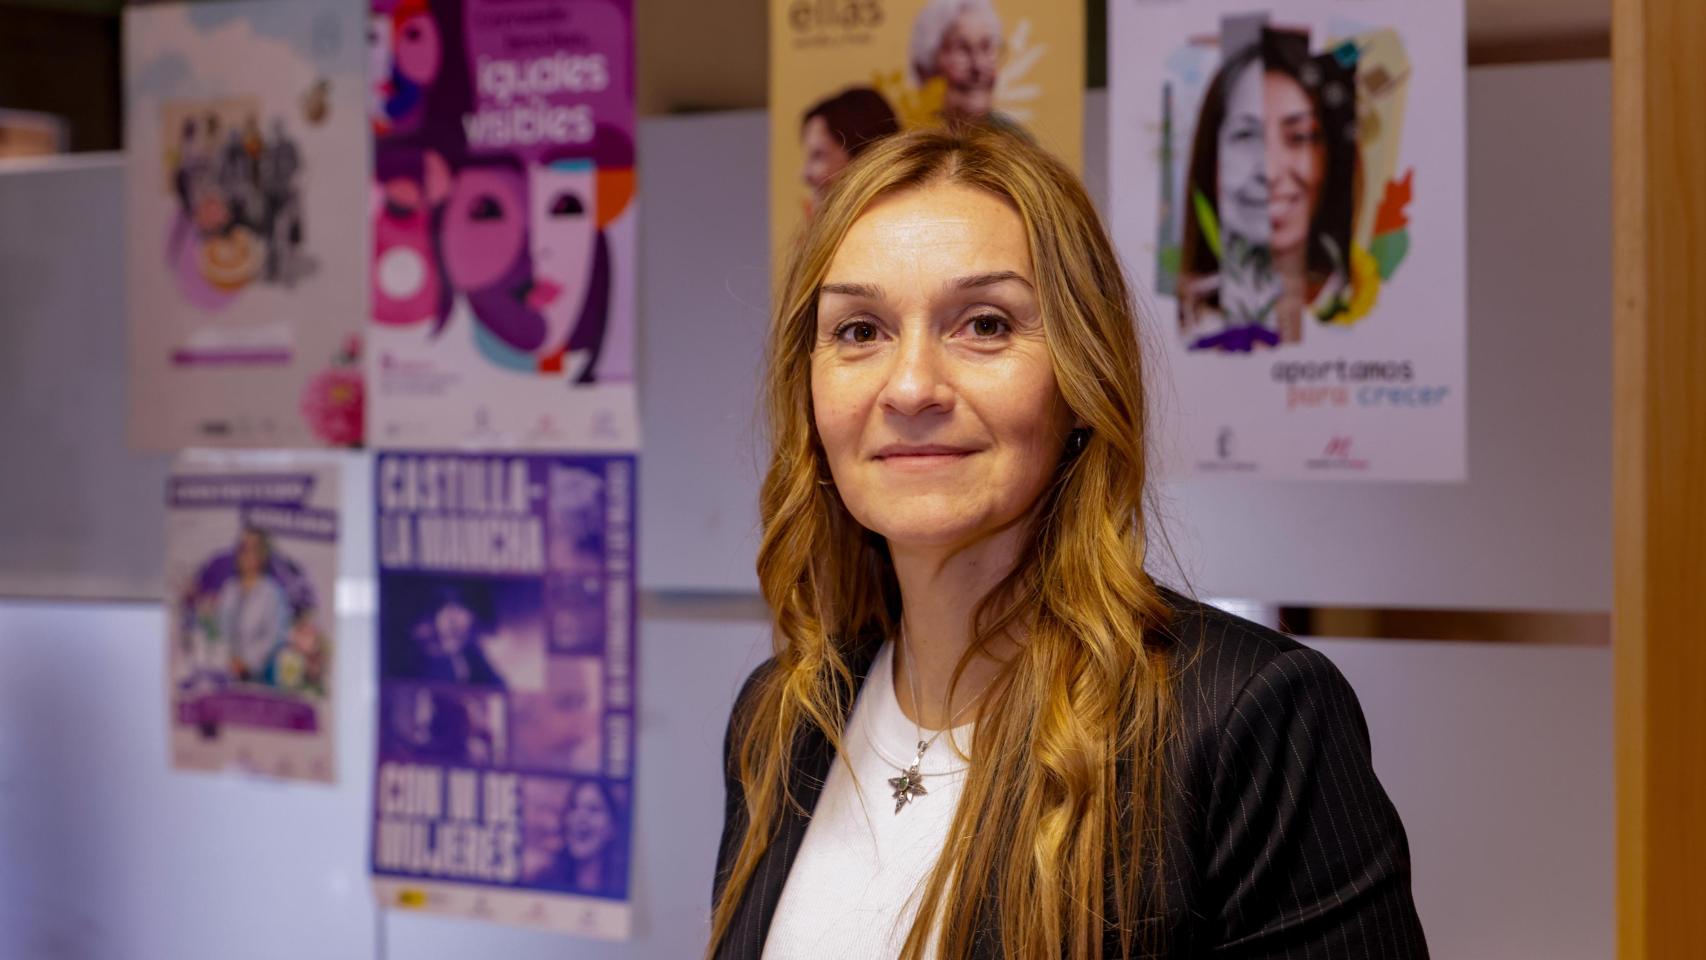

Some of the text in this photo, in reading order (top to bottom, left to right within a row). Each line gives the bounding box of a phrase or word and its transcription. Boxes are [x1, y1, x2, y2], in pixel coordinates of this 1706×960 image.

[476, 52, 608, 103] iguales
[1271, 358, 1414, 383] aportamos
[1286, 385, 1450, 410] para crecer
